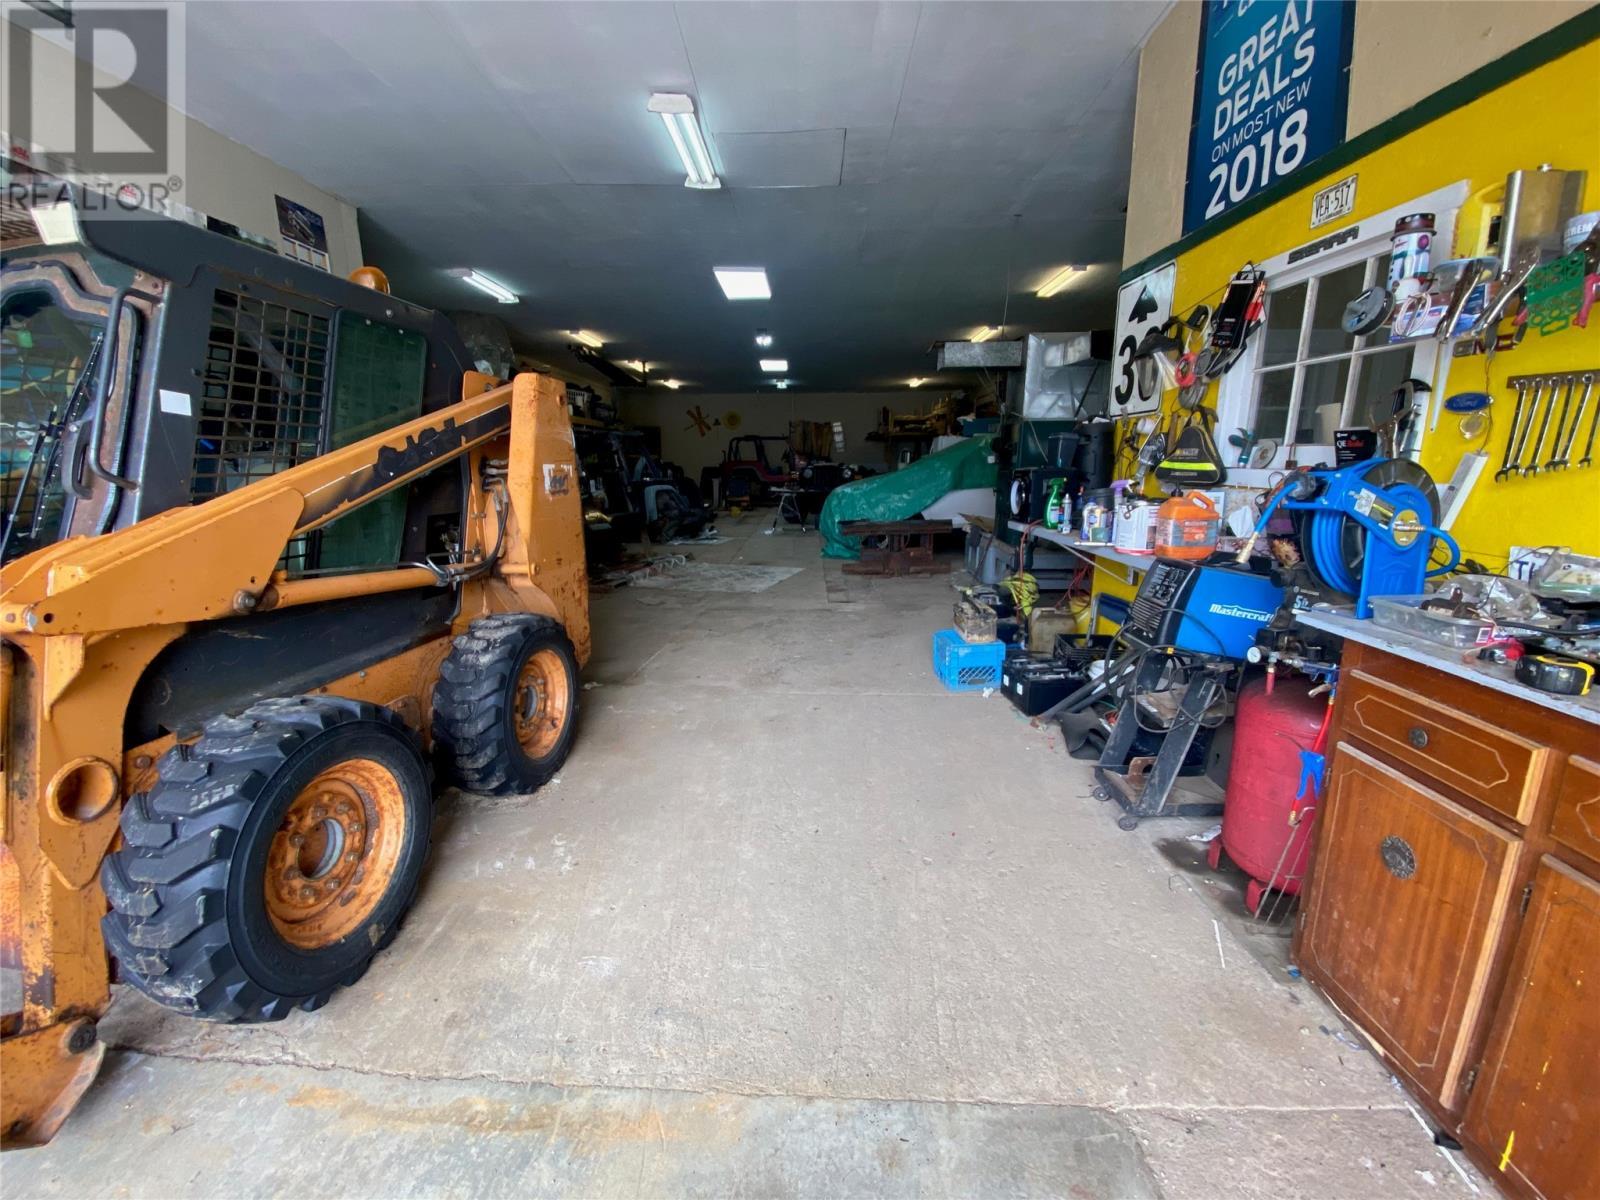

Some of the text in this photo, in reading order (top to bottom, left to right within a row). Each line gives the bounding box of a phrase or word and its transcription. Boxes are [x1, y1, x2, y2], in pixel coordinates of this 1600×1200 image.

[1211, 76, 1312, 163] ON MOST NEW
[1213, 27, 1316, 141] DEALS
[1205, 108, 1308, 220] 2018
[1209, 603, 1274, 622] Mastercraft
